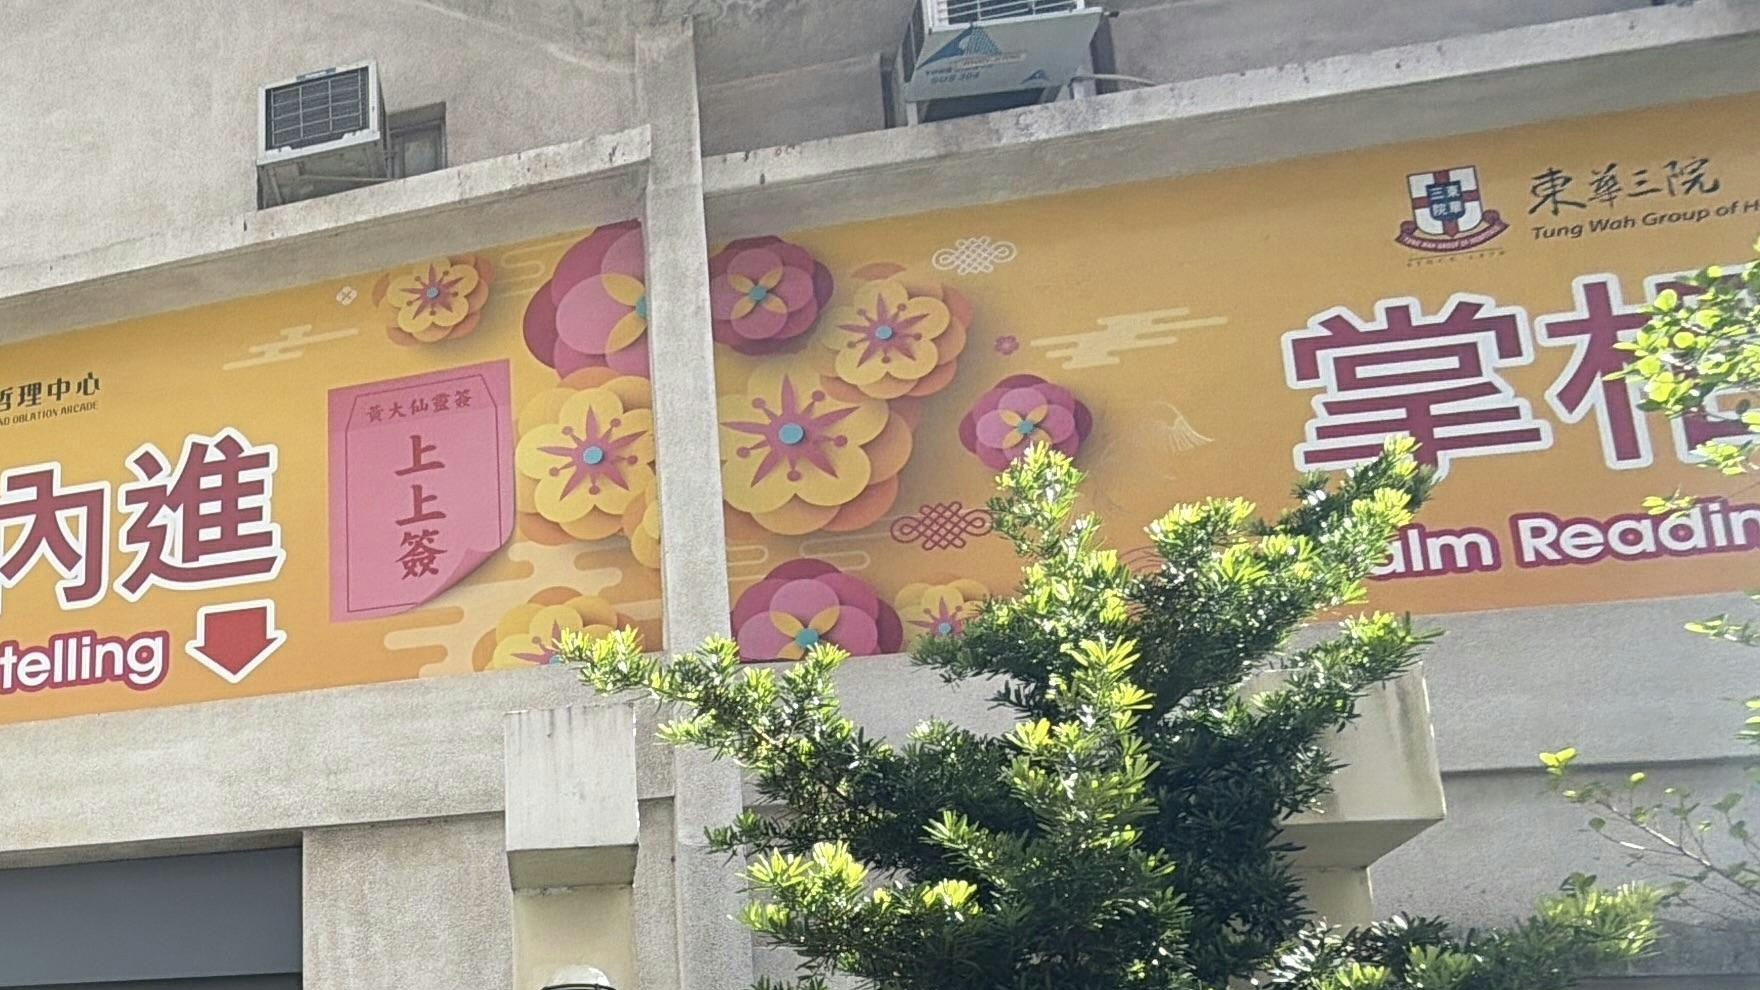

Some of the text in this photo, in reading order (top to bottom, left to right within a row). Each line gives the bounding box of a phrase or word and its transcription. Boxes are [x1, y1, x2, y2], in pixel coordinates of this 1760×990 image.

[1528, 157, 1721, 216] 東華三院
[1531, 224, 1583, 240] Tung
[1589, 215, 1635, 232] Wah
[1642, 208, 1710, 226] Group
[1716, 200, 1740, 216] of
[12, 407, 58, 425] OBLATION
[61, 401, 97, 415] ARCADE
[394, 434, 448, 580] 上上簽
[1368, 525, 1494, 578] alm
